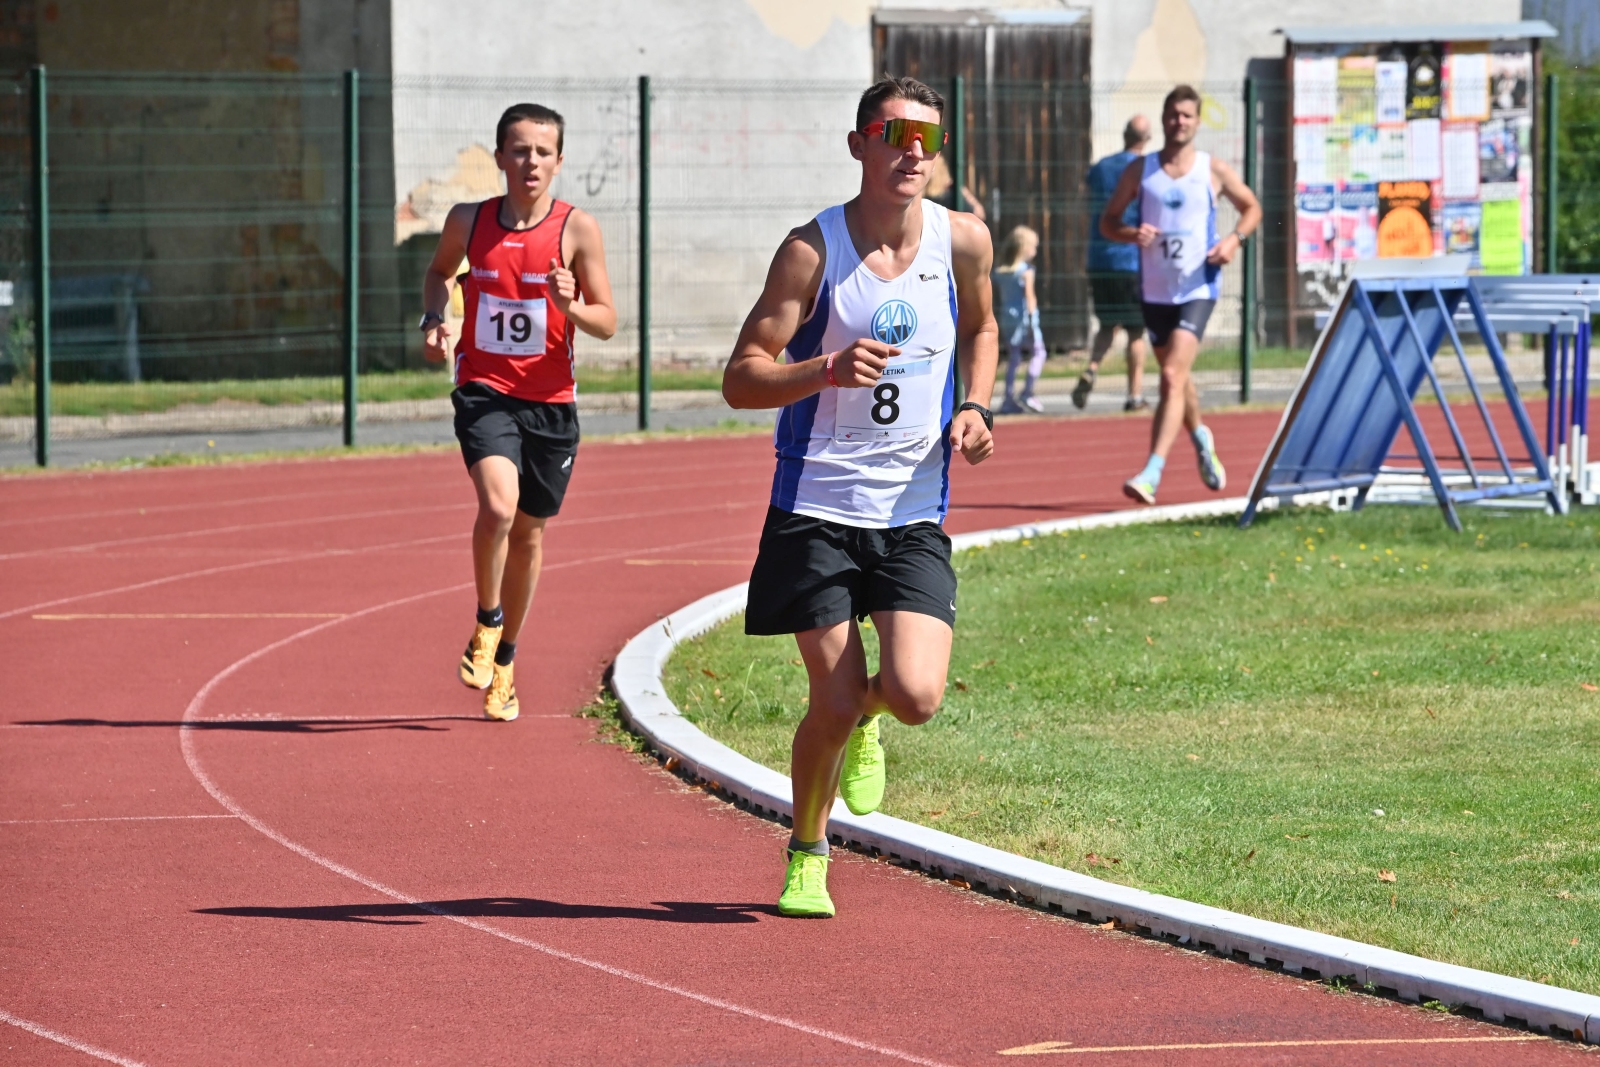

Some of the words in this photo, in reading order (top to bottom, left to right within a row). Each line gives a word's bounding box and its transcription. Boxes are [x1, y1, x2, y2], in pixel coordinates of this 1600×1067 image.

[1159, 238, 1183, 259] 12
[490, 311, 532, 343] 19
[871, 383, 900, 425] 8
